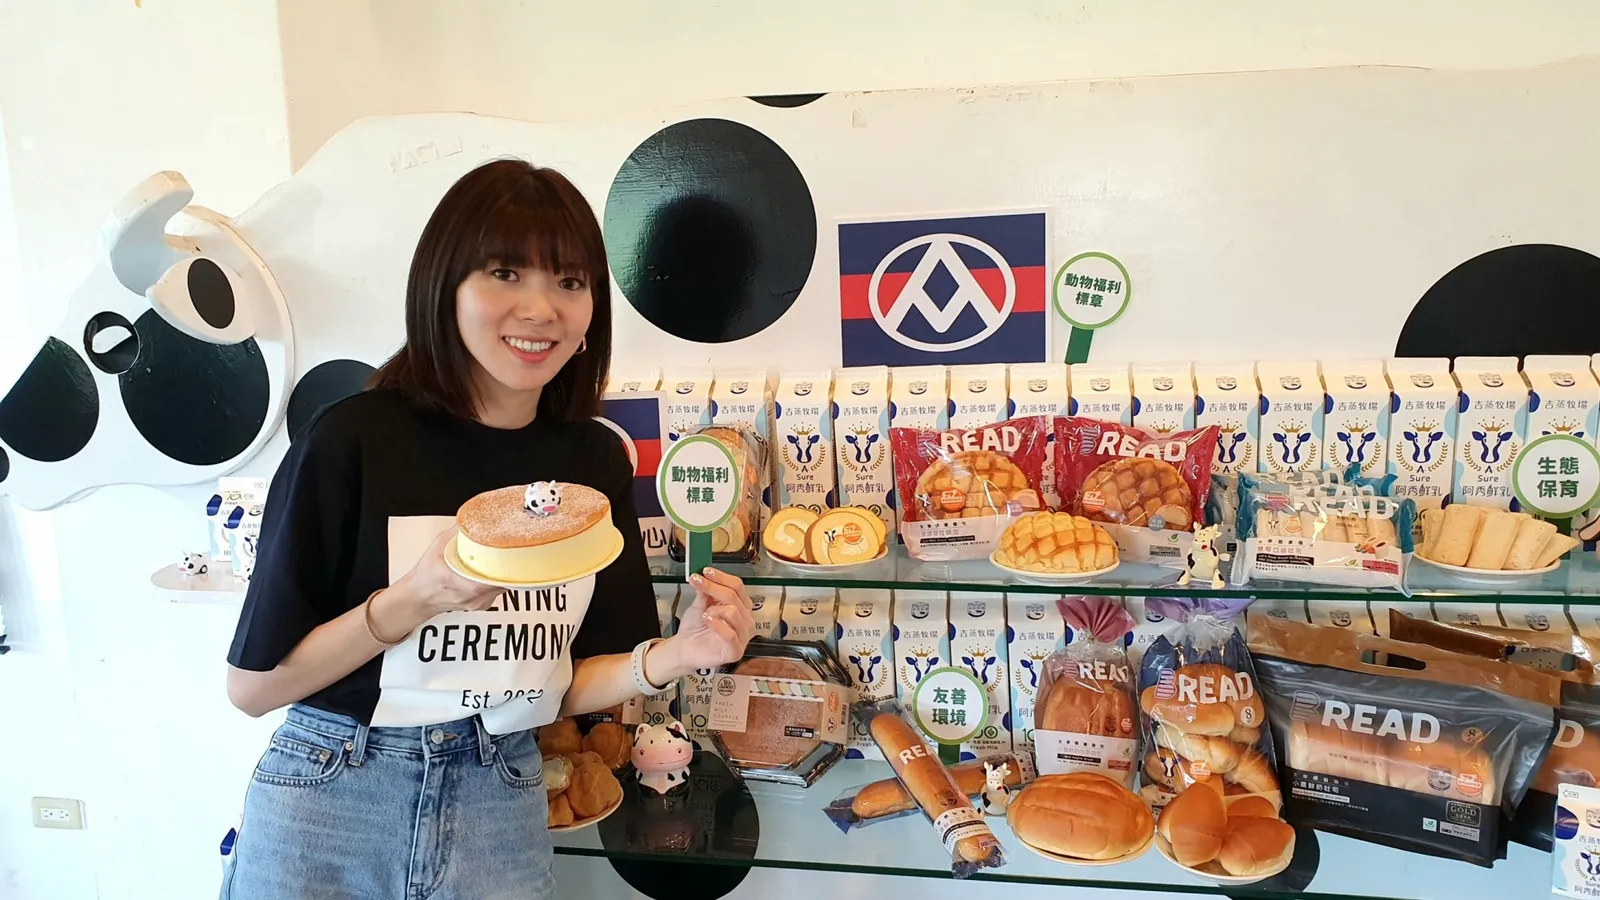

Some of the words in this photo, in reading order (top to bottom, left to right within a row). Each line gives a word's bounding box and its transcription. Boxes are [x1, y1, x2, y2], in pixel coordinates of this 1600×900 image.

[1064, 273, 1122, 294] 動物福利
[1075, 291, 1103, 307] 標章
[1537, 456, 1580, 476] 生態
[671, 465, 729, 484] 動物福利
[796, 473, 814, 481] Sure
[855, 473, 874, 481] Sure
[1409, 475, 1431, 483] Sure
[1477, 475, 1499, 483] Sure
[686, 486, 715, 504] 標章
[786, 482, 825, 494] 阿秀鮮乳
[845, 482, 885, 494] 阿秀鮮乳
[1395, 484, 1442, 497] 阿秀鮮乳
[1462, 484, 1512, 497] 阿秀鮮乳
[1536, 479, 1580, 498] 保育
[446, 584, 568, 612] NING
[461, 690, 494, 709] Est.
[933, 687, 967, 706] 友善
[931, 708, 967, 726] 環境
[1450, 804, 1477, 817] GOLD
